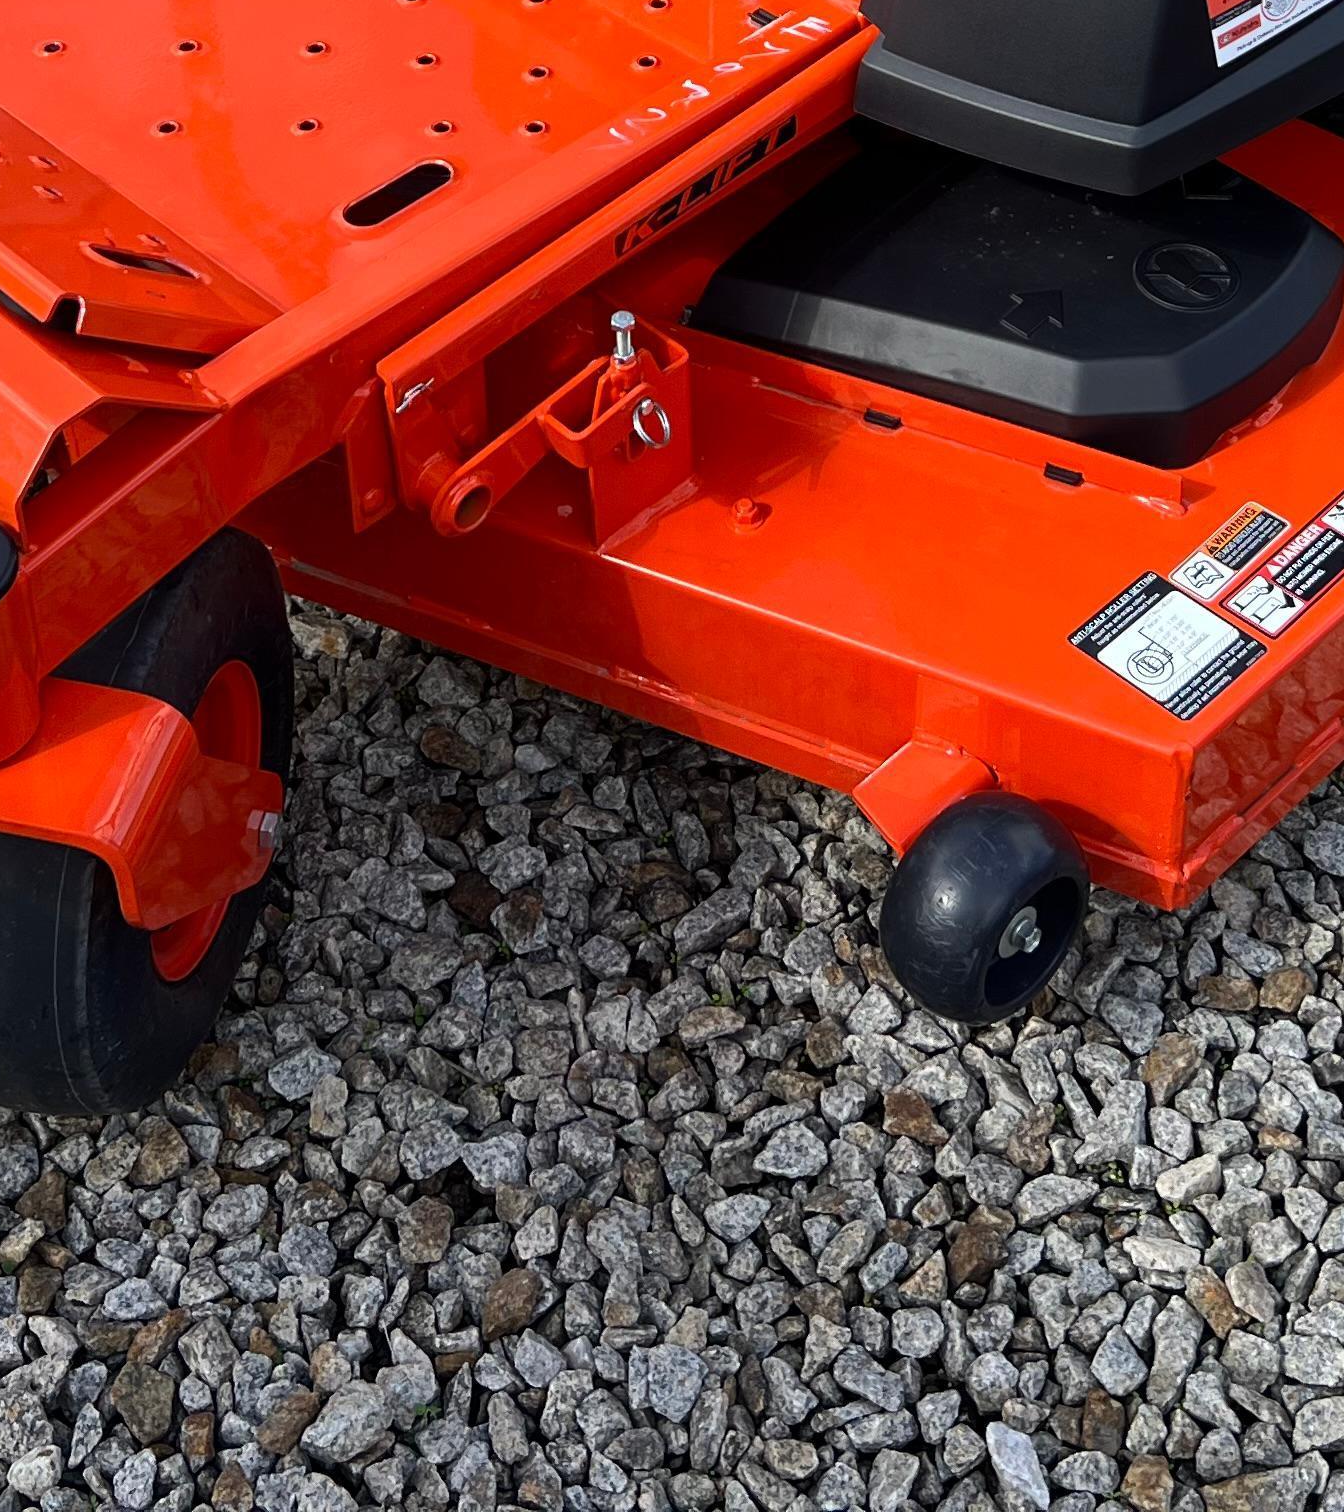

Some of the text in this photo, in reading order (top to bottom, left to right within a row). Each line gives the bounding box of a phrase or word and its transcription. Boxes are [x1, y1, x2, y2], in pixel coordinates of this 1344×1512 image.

[1212, 507, 1258, 547] WARNING
[1271, 522, 1326, 566] DANGER
[1103, 592, 1132, 616] ROLLER
